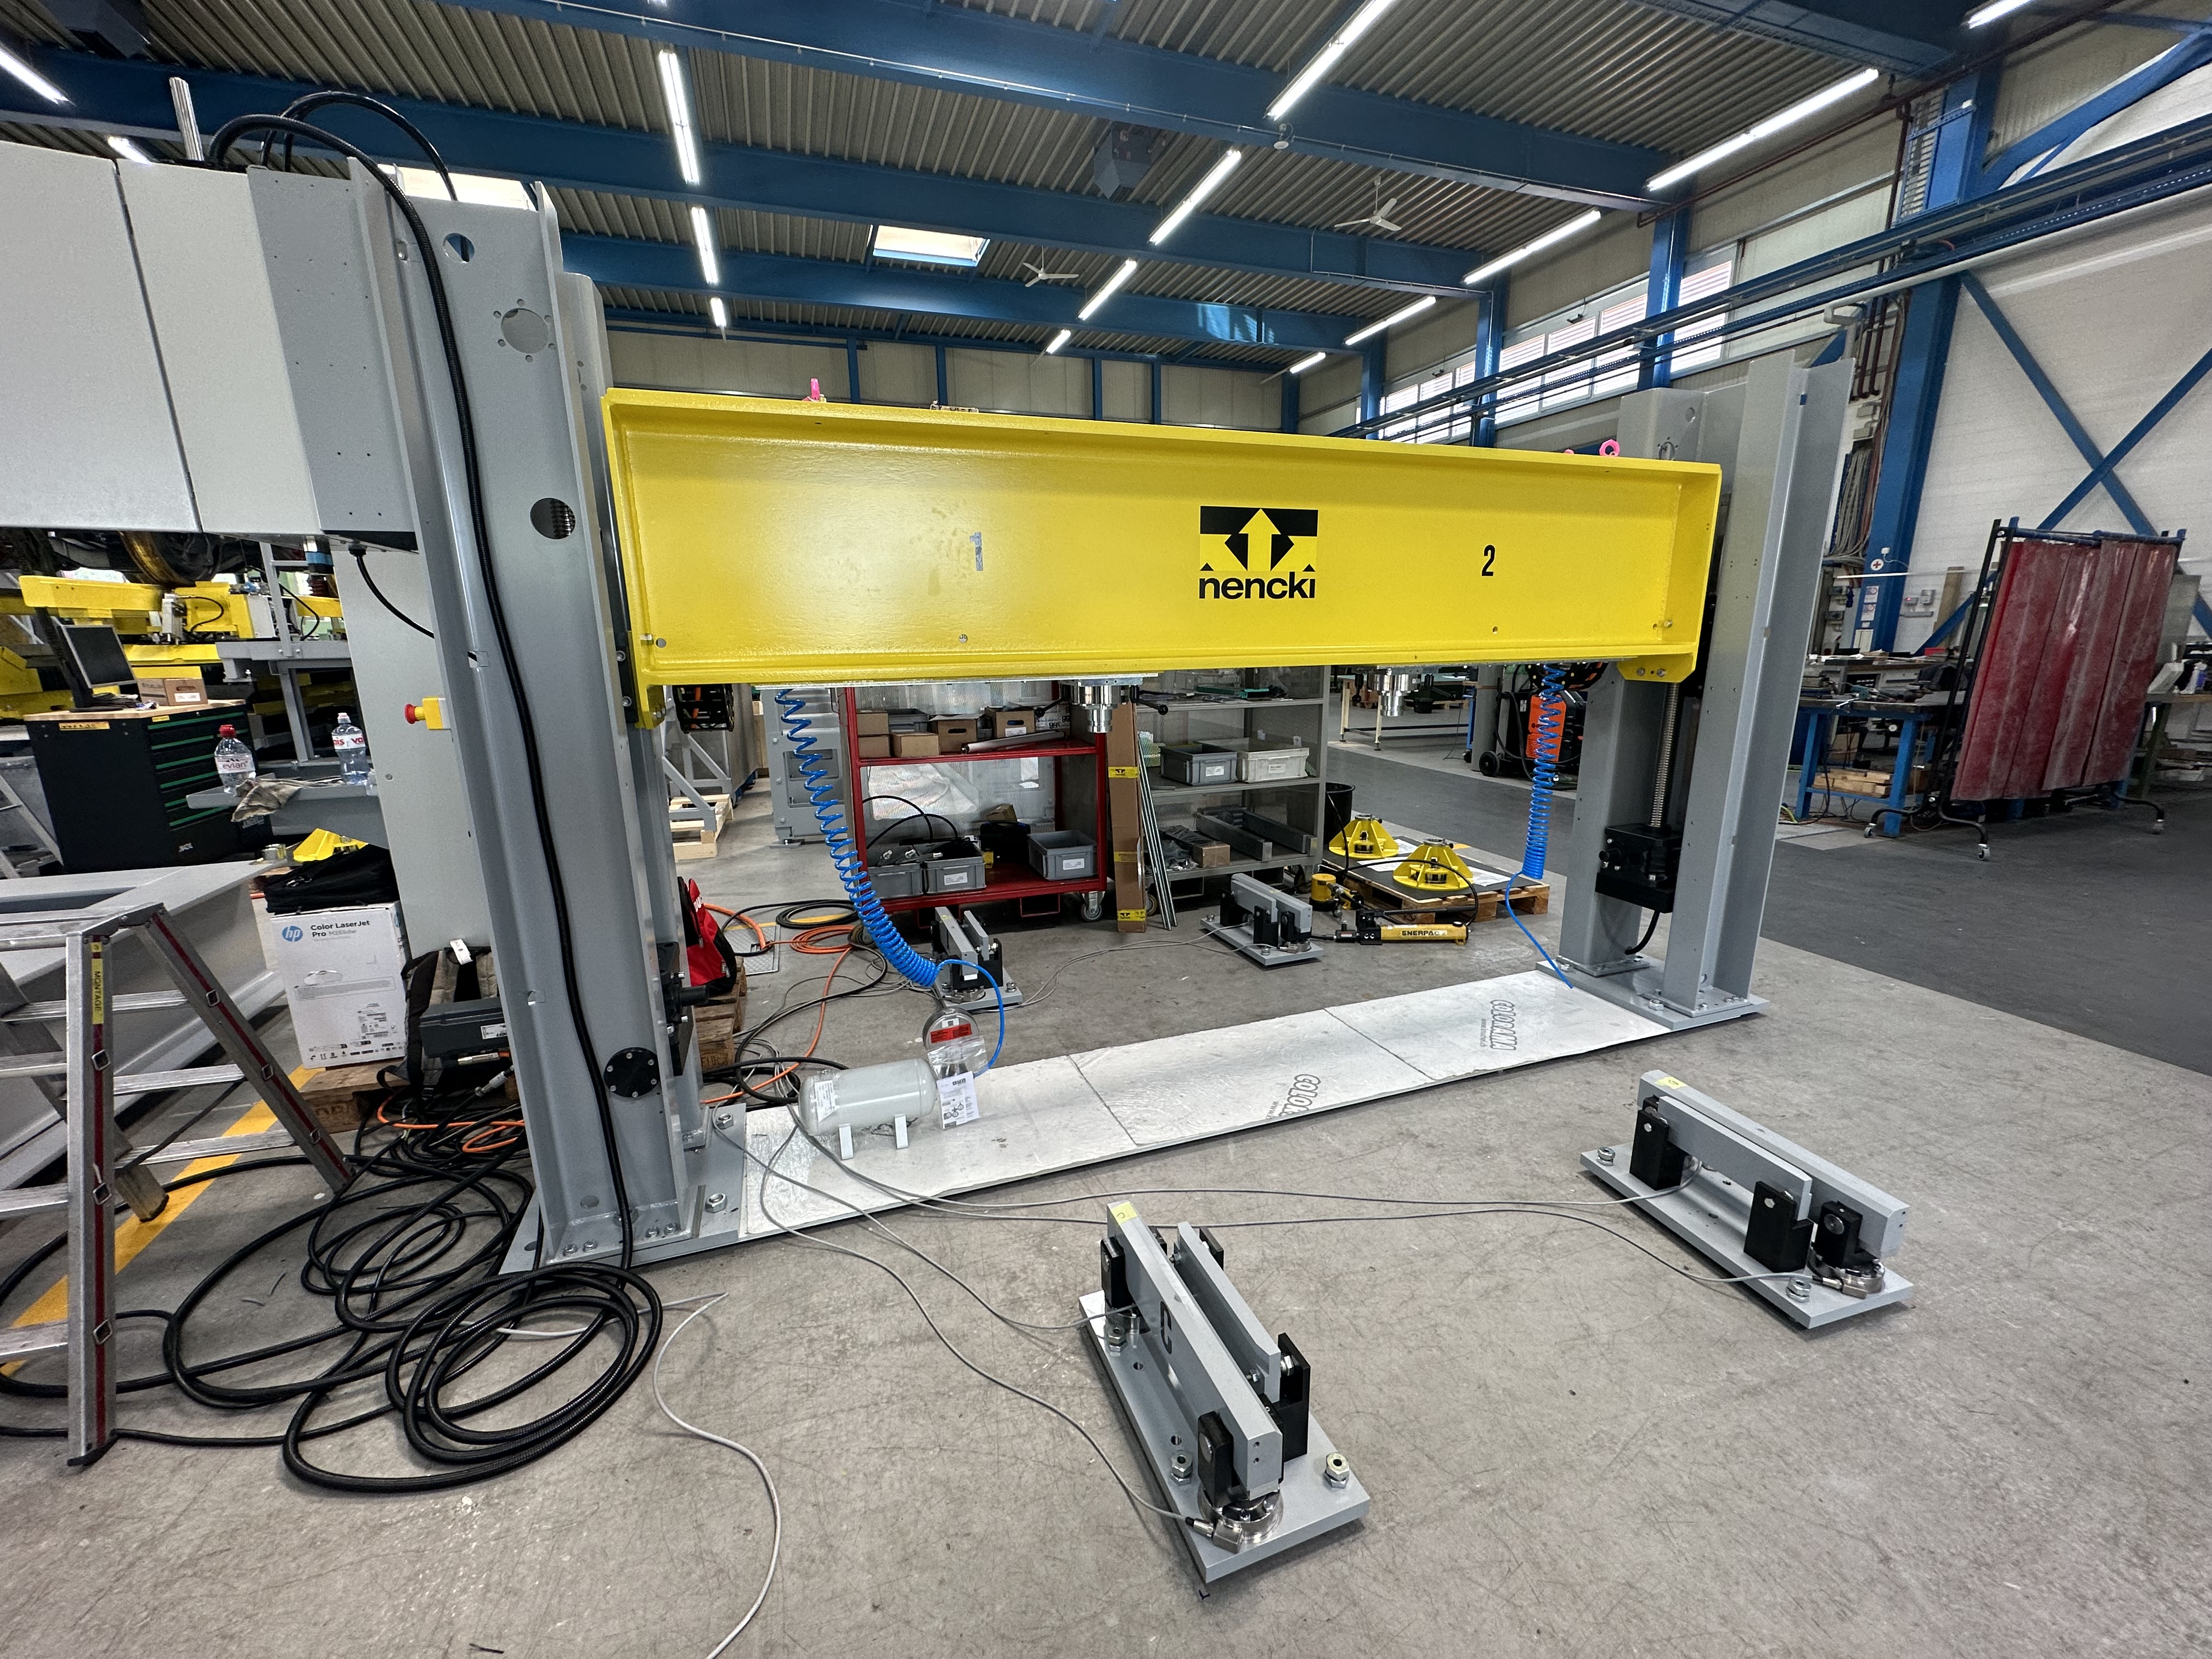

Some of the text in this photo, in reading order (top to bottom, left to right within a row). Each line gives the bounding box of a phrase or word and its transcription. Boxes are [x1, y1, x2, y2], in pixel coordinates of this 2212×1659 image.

[1481, 544, 1496, 577] 2
[1199, 571, 1316, 599] nencki
[285, 926, 301, 941] hp
[94, 971, 102, 1012] MONTAGE
[1489, 1000, 1517, 1051] COLORAMA
[1278, 1074, 1321, 1117] COLOR
[1160, 1301, 1172, 1355] C
